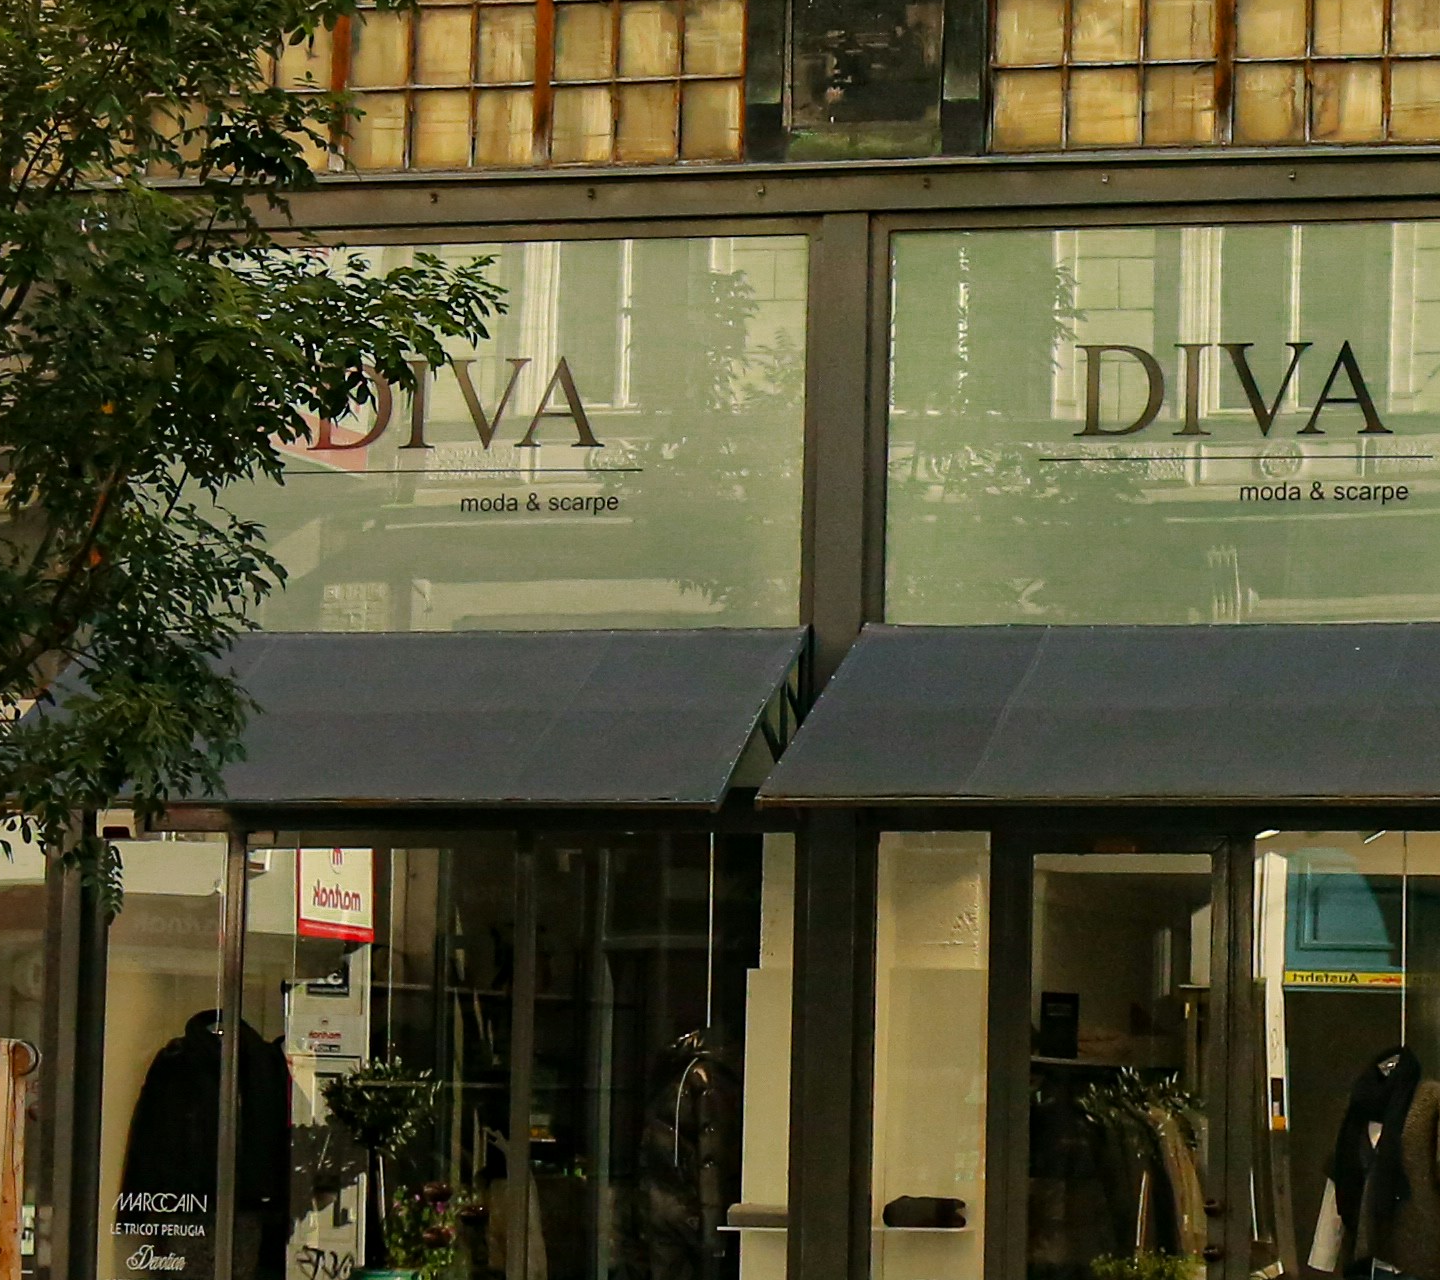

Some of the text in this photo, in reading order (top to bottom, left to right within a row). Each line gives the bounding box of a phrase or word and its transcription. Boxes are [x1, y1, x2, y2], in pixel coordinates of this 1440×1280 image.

[1073, 340, 1394, 437] DIVA
[306, 356, 606, 450] DIVA
[460, 493, 619, 516] moda & scarpe
[1240, 482, 1409, 505] moda & scarpe
[110, 1223, 205, 1236] LE TRICOT PERUGIA
